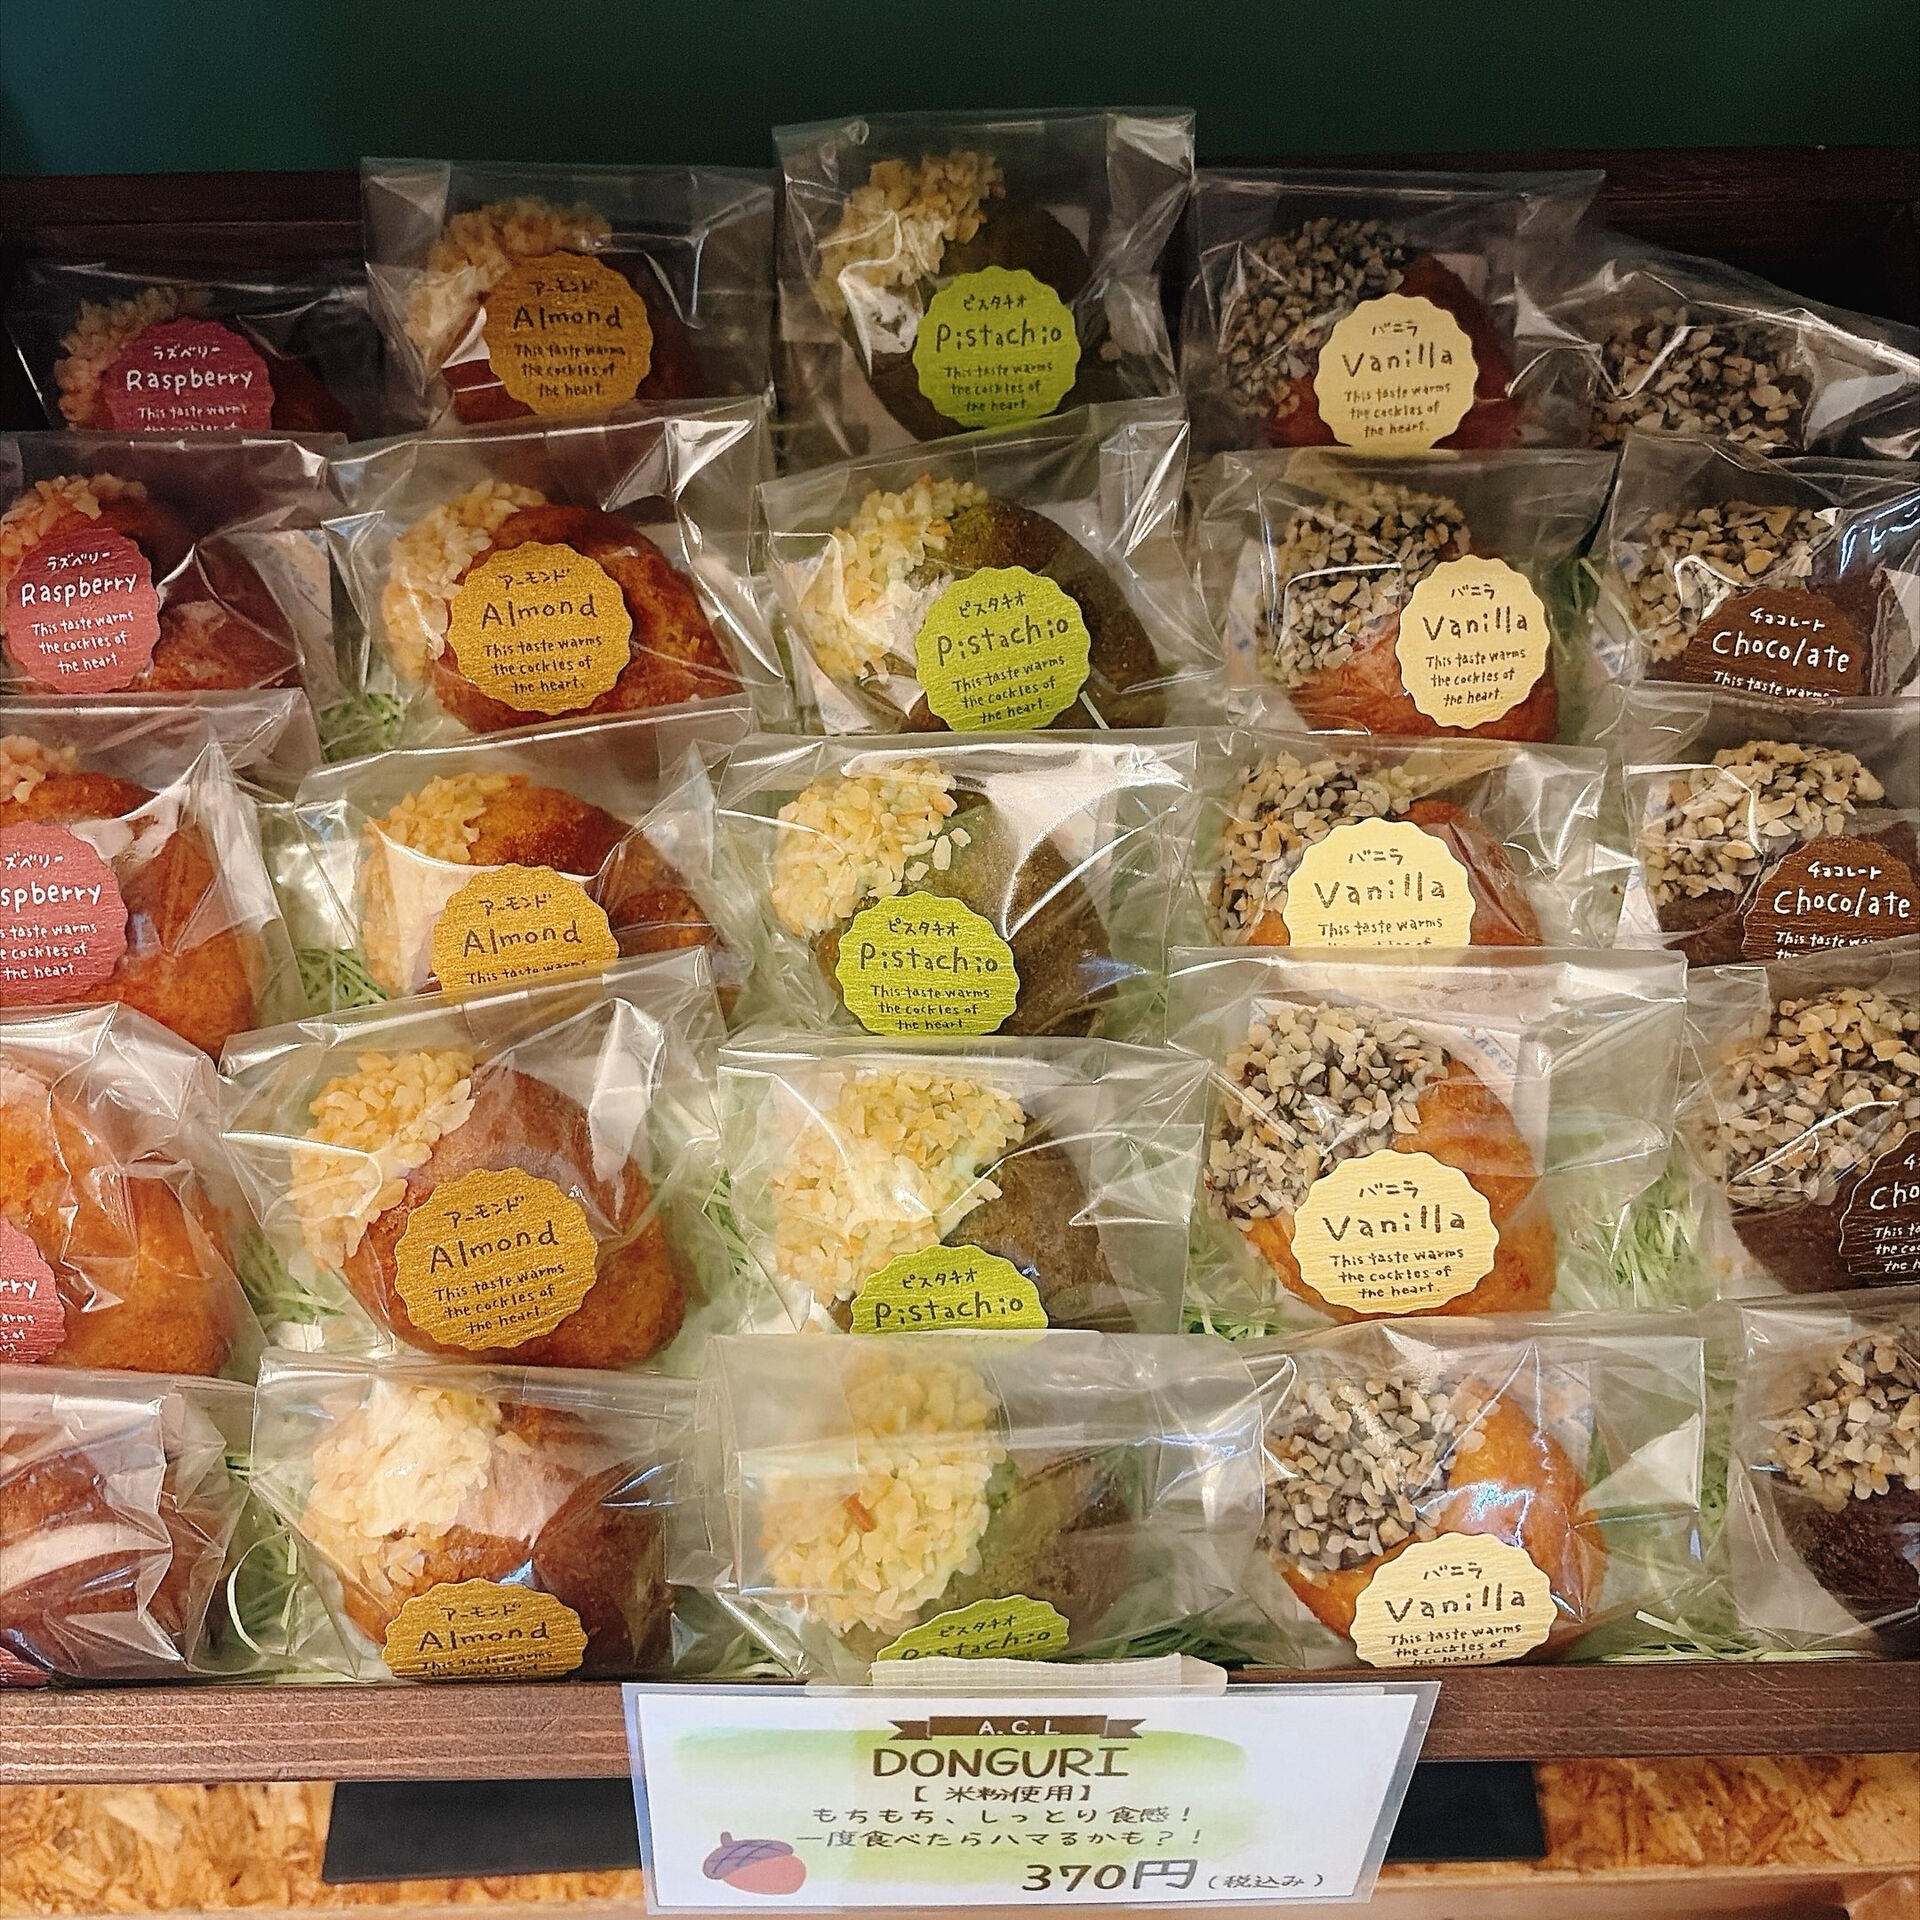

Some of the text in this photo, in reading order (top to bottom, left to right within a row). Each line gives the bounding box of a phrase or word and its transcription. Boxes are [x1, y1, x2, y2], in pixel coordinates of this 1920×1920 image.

[963, 294, 1027, 311] ピスタキオ
[513, 305, 622, 330] Almond
[936, 319, 1062, 352] Pistachio
[1372, 320, 1418, 337] バニラ
[514, 344, 544, 357] This
[1342, 341, 1452, 378] Vanilla
[522, 363, 543, 378] the
[602, 362, 615, 376] of
[1013, 362, 1052, 375] warms
[126, 368, 252, 395] Raspberry
[952, 383, 970, 395] the
[1029, 380, 1041, 394] of
[1344, 383, 1451, 403] This taste warms
[138, 407, 166, 421] This
[169, 406, 203, 419] taste
[965, 401, 986, 412] the
[1350, 401, 1439, 420] the cockles of
[1364, 426, 1384, 438] the
[47, 552, 111, 571] ラズベリー
[498, 569, 570, 590] アーモンド
[21, 573, 137, 608] Raspberry
[1451, 584, 1495, 600] バニラ
[481, 594, 598, 630] Almond
[959, 590, 1026, 618] ピスタキオ
[31, 611, 134, 637] This taste warms
[1422, 606, 1528, 641] Vanilla
[1749, 608, 1826, 632] チョコレート
[39, 631, 128, 655] the cockles of
[485, 635, 602, 658] This taste warms
[938, 615, 1068, 667] Pistachio
[1426, 649, 1525, 669] This taste warms
[1712, 630, 1850, 673] Chocolate
[58, 660, 79, 674] the
[492, 655, 592, 676] the cockles of
[952, 655, 1065, 694] This taste warms
[511, 681, 535, 694] the
[1431, 668, 1515, 687] the cockles of
[1713, 670, 1782, 696] This taste
[962, 676, 1056, 709] the cockles of
[1443, 693, 1462, 707] the
[980, 712, 1002, 724] the
[0, 852, 64, 870] ズベリー
[1349, 848, 1403, 865] バニラ
[1807, 861, 1882, 880] チョコレート
[0, 880, 101, 913] spberry
[1314, 872, 1445, 909] Vanilla
[479, 894, 552, 916] アーモンド
[1774, 887, 1911, 918] Chocolate
[10, 925, 48, 940] taste
[51, 922, 98, 936] warms
[888, 918, 959, 937] ピスタキオ
[1318, 918, 1443, 938] This taste warms
[463, 919, 582, 958] Almond
[1776, 932, 1804, 945] This
[1810, 933, 1844, 948] taste
[12, 943, 68, 960] cockles
[73, 942, 87, 956] of
[860, 942, 998, 973] Pistachio
[3, 967, 28, 981] the
[466, 972, 498, 985] This
[871, 984, 990, 998] This taste warms
[878, 1003, 978, 1015] the cockles of
[896, 1019, 919, 1030] the
[1359, 1181, 1419, 1198] バニラ
[443, 1195, 525, 1228] アーモンド
[1322, 1204, 1465, 1241] Vanilla
[1873, 1226, 1902, 1239] This
[429, 1220, 559, 1274] Almond
[1875, 1244, 1897, 1255] the
[1329, 1248, 1464, 1268] This taste warms
[433, 1263, 564, 1302] This taste warms
[902, 1268, 978, 1288] ピスタキオ
[1339, 1266, 1452, 1283] the cockles of
[444, 1283, 555, 1318] the cockles of
[1358, 1282, 1441, 1299] the heart.
[875, 1291, 1024, 1328] Pistachio
[466, 1320, 492, 1334] the
[1424, 1562, 1482, 1580] バニラ
[440, 1604, 521, 1621] アーモンド
[1385, 1583, 1525, 1623] Vanilla
[419, 1621, 549, 1652] Almond
[940, 1615, 1017, 1638] ピスタキオ
[1388, 1624, 1522, 1645] This taste warms
[1394, 1648, 1418, 1658] the
[1491, 1639, 1506, 1649] of
[979, 1720, 1060, 1736] A.C.L
[873, 1748, 1129, 1778] DONGURI
[1021, 1859, 1199, 1892] 370円
